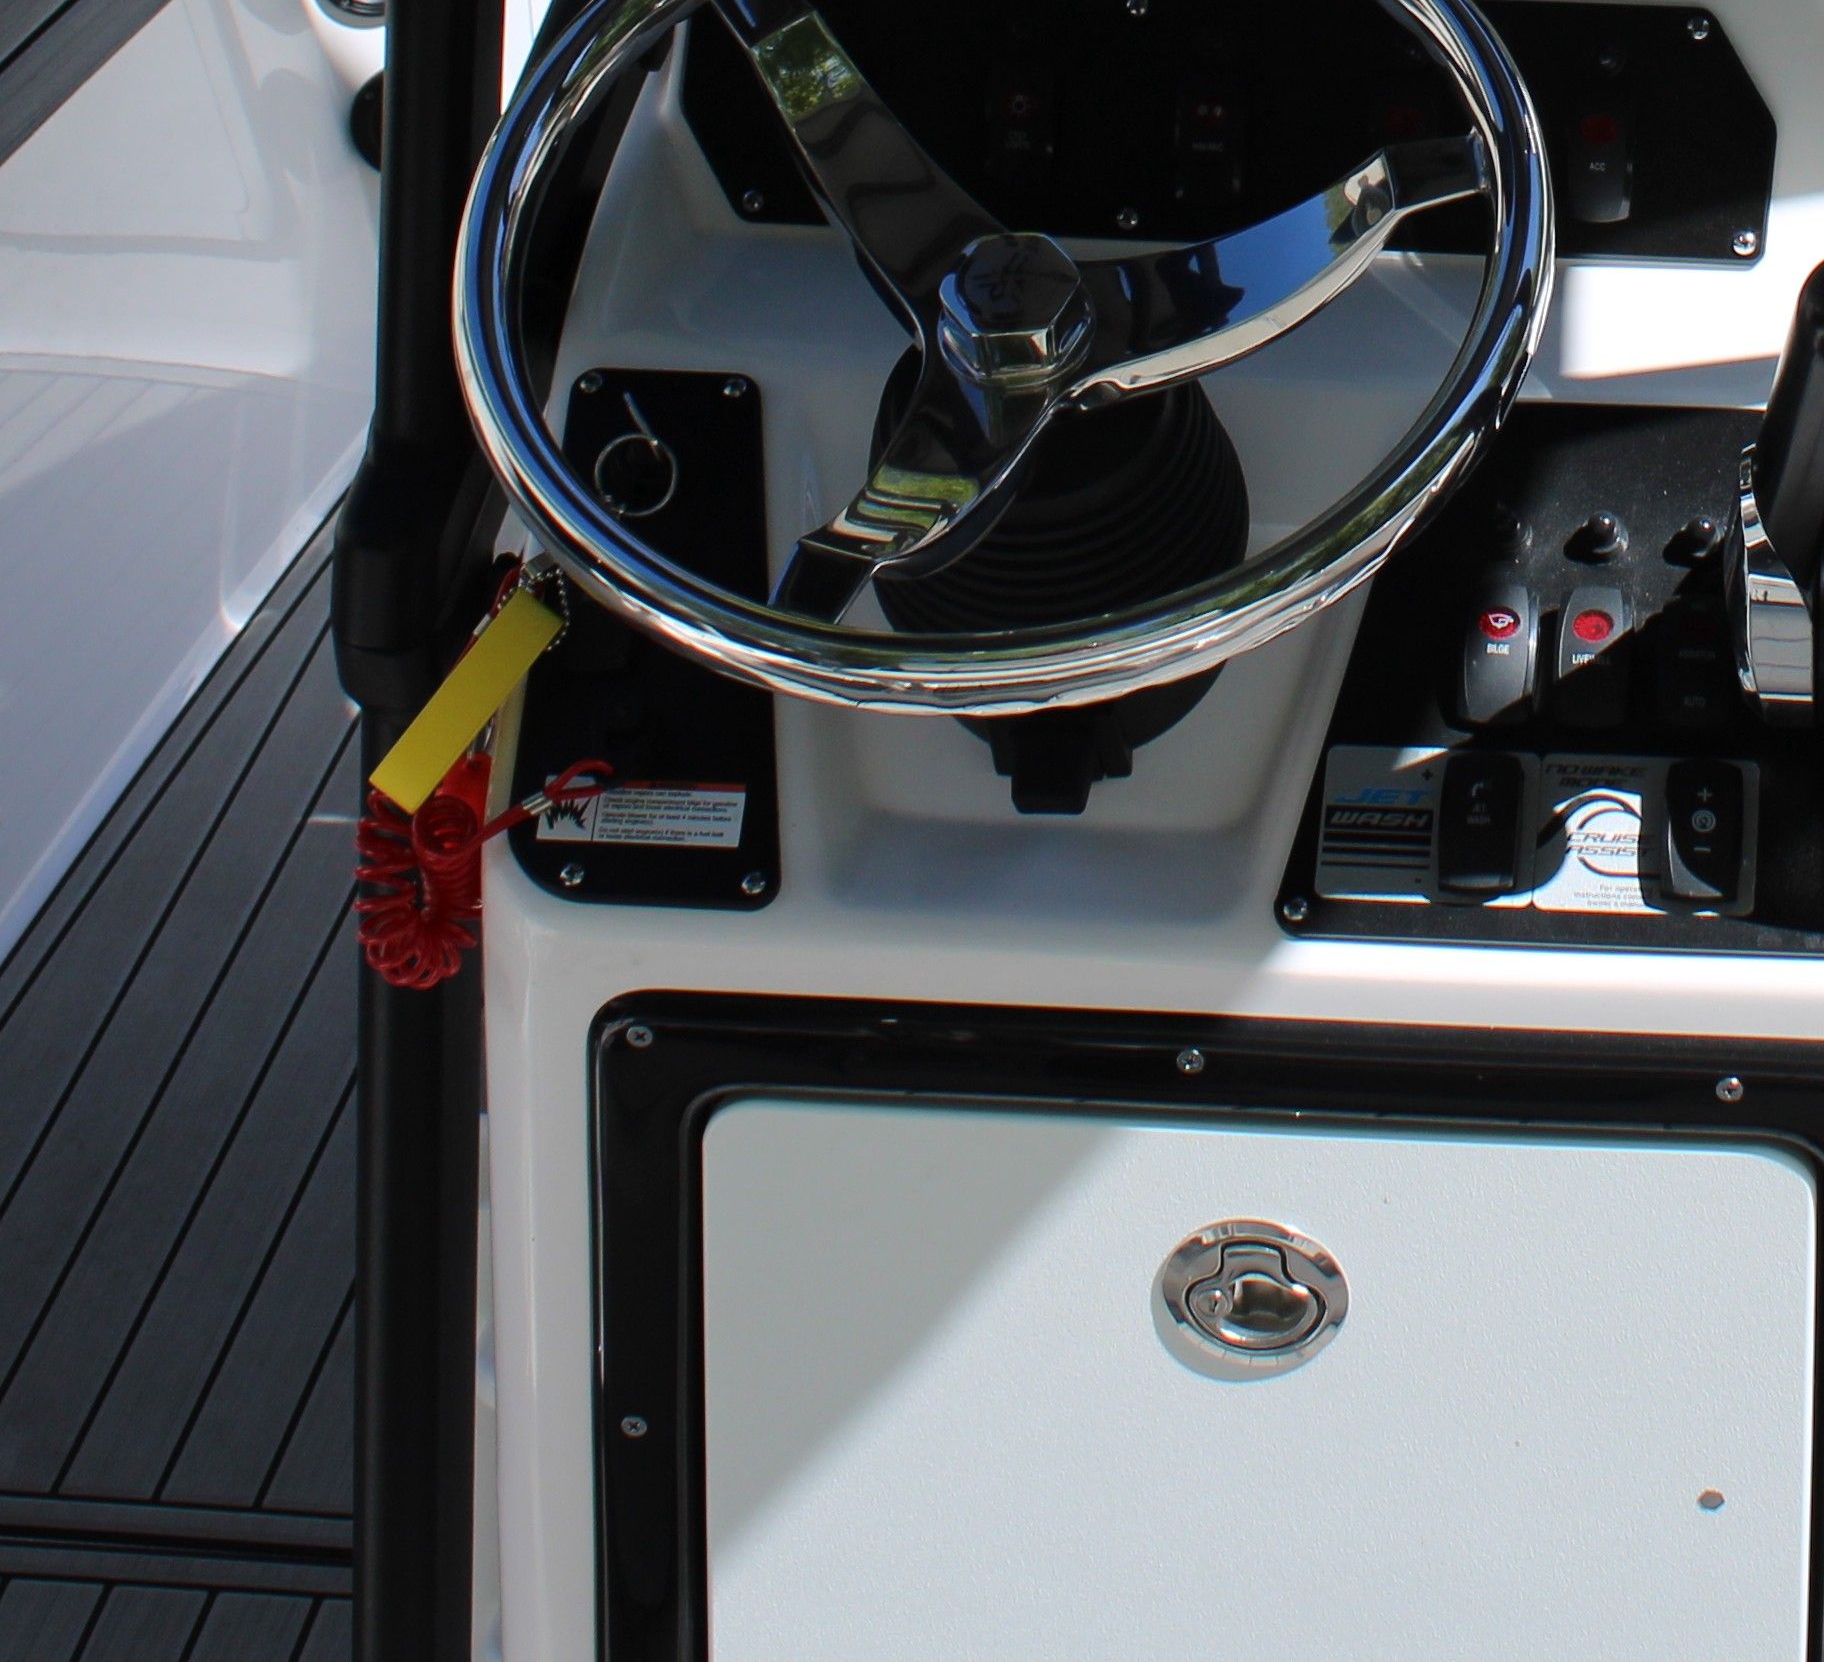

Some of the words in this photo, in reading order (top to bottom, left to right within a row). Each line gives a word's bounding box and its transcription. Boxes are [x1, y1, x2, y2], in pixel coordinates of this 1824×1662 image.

[1486, 642, 1511, 655] BILGE
[1545, 764, 1580, 774] NO
[1335, 787, 1433, 805] JET
[1328, 810, 1431, 829] WASH
